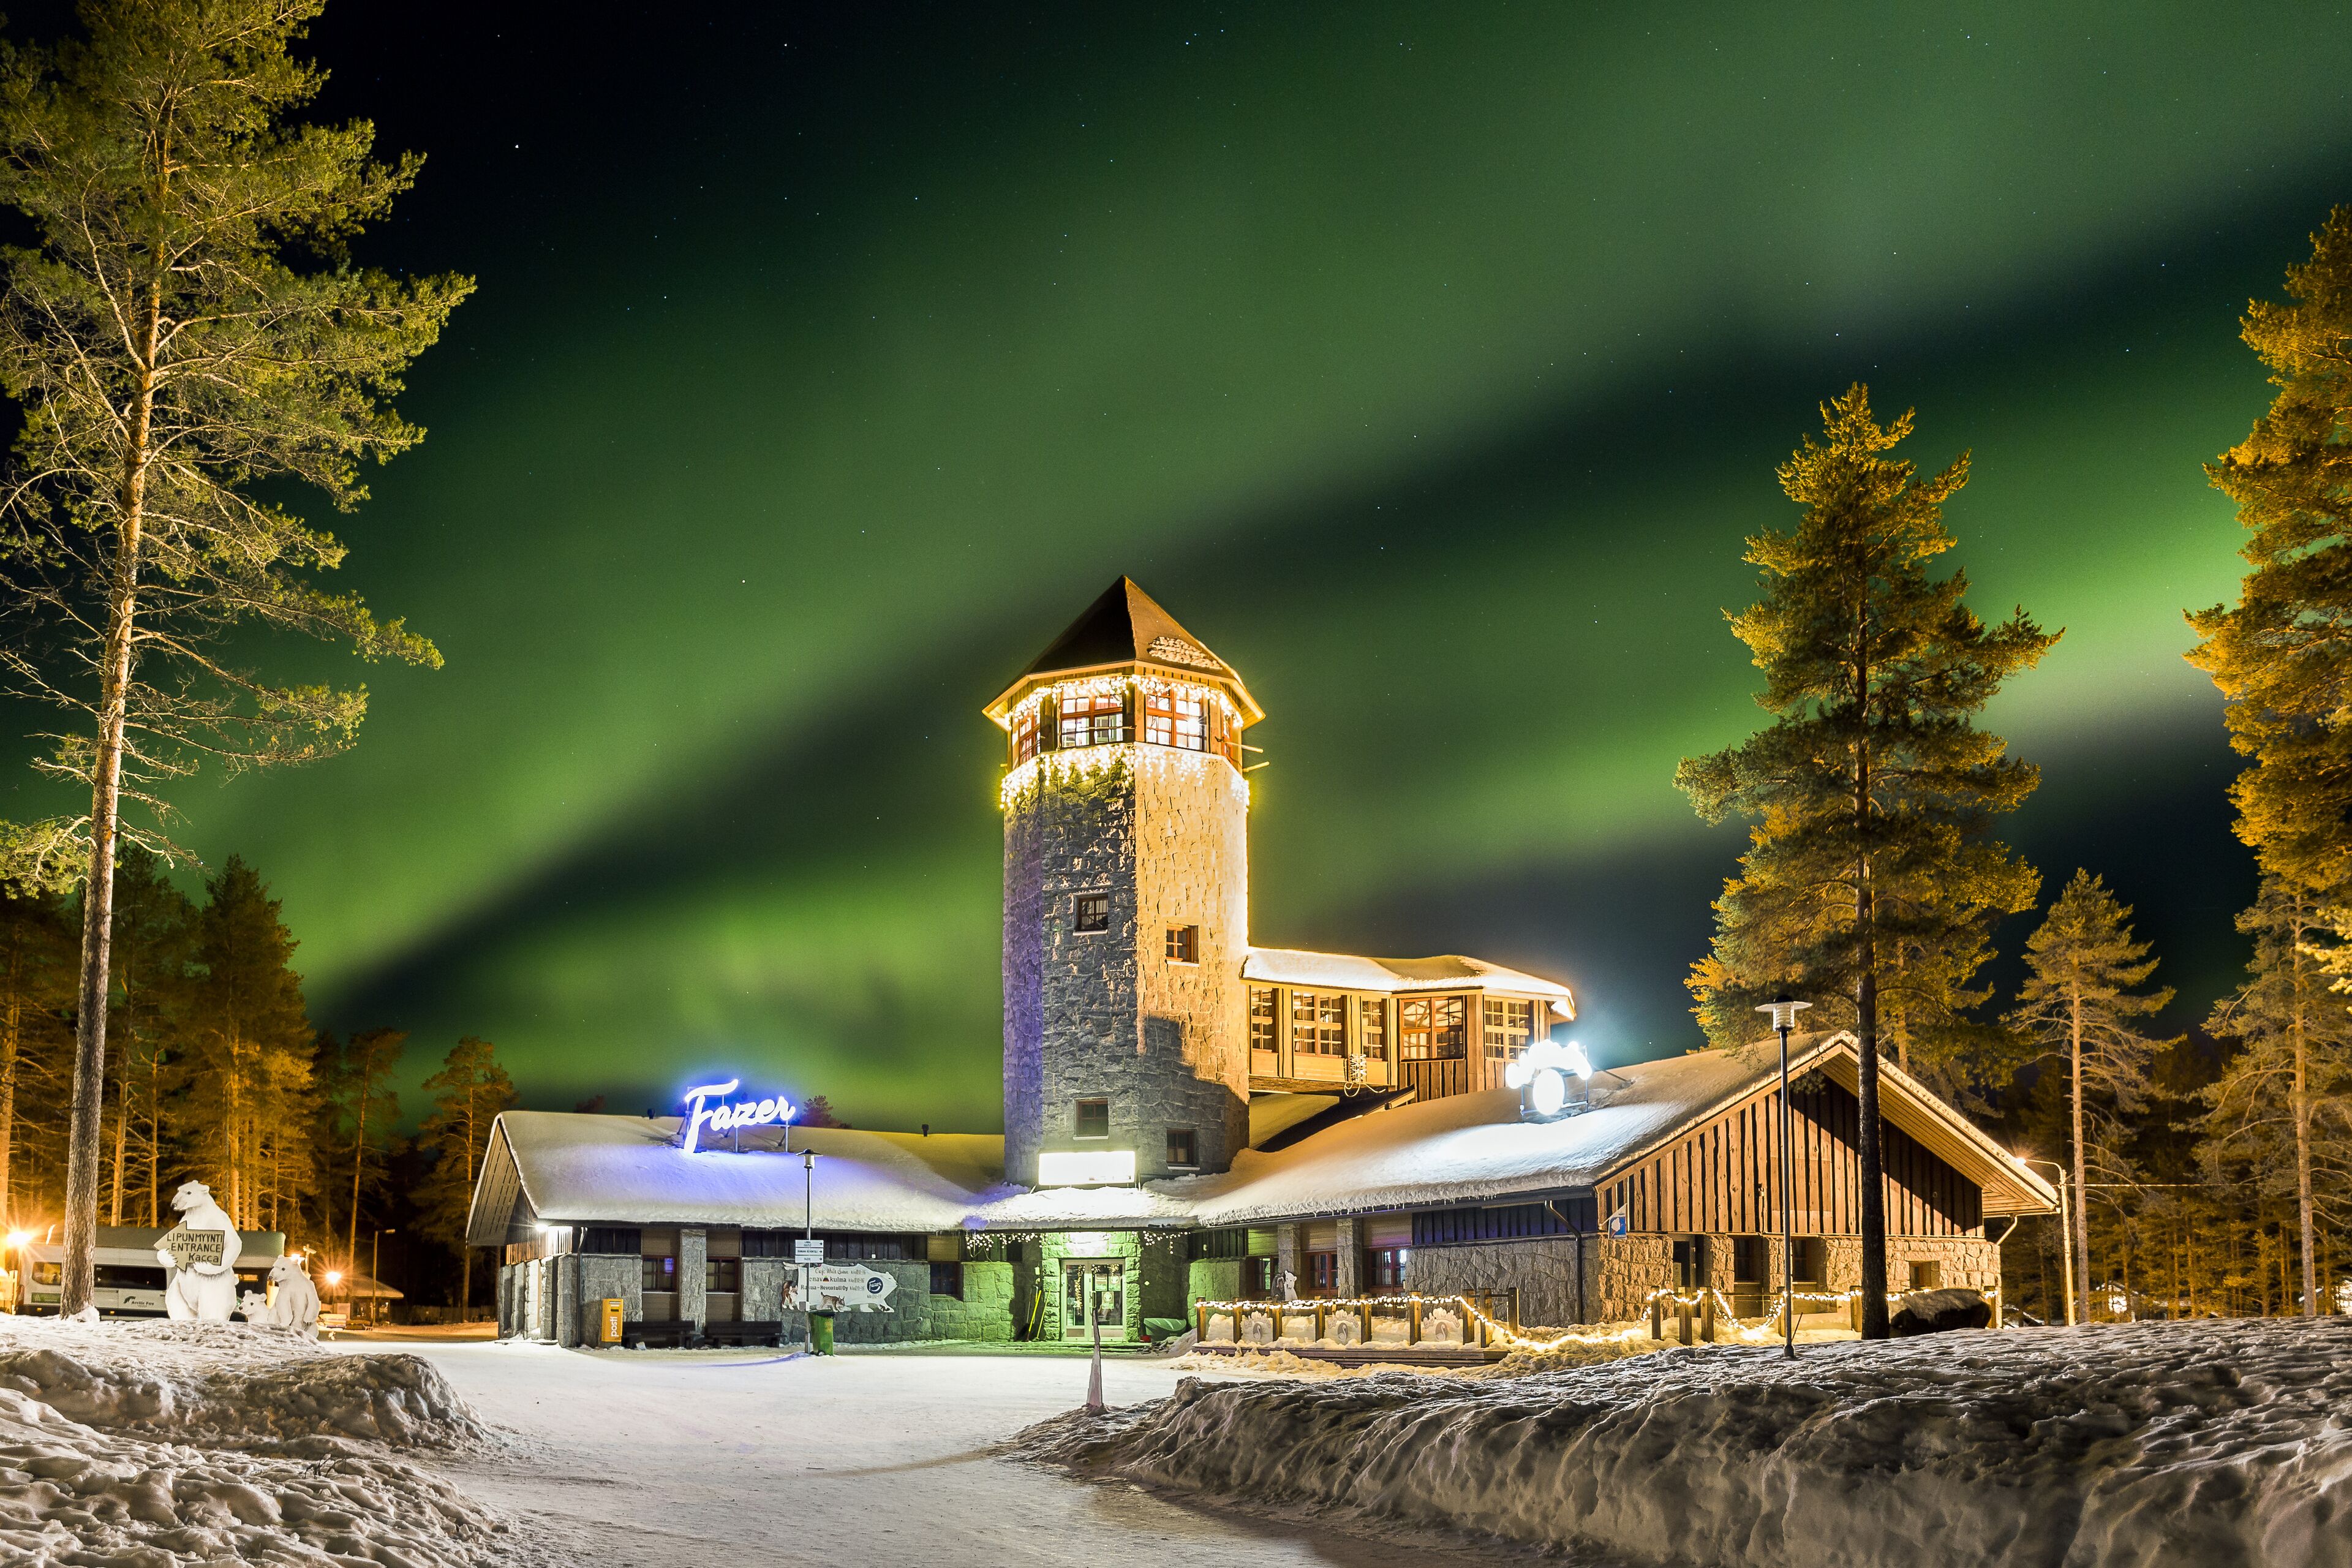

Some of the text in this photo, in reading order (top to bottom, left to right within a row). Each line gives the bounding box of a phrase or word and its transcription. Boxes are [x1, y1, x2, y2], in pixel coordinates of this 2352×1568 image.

[684, 1079, 796, 1153] Fazer
[167, 1233, 222, 1243] LIPUNMYYNTI
[171, 1243, 221, 1252] ENTRANCE
[609, 1316, 619, 1337] posti
